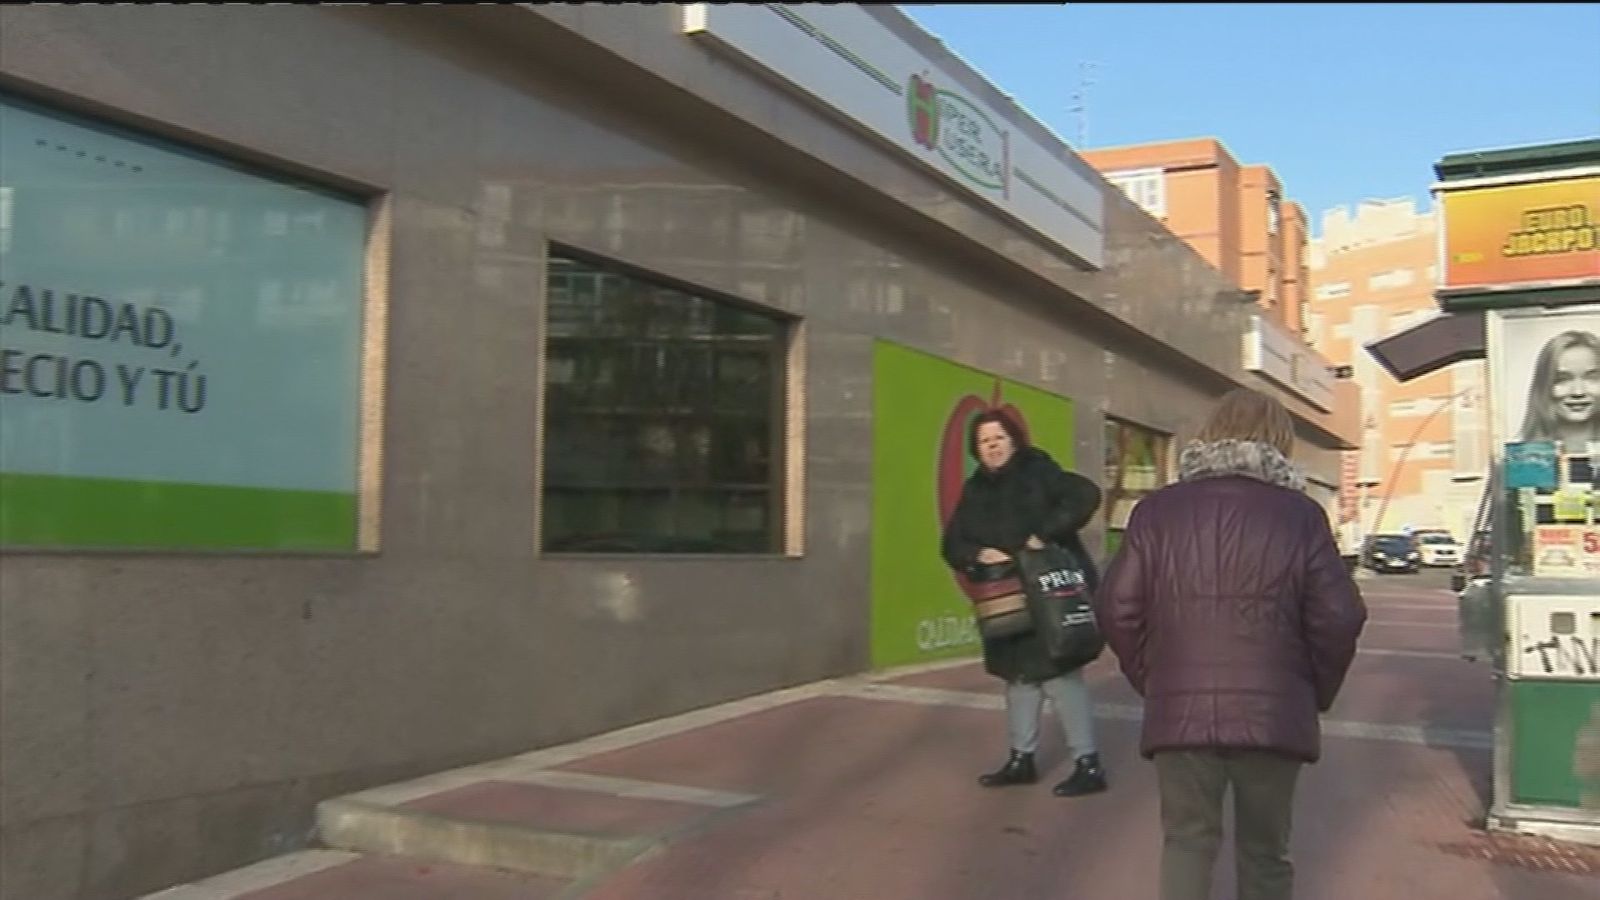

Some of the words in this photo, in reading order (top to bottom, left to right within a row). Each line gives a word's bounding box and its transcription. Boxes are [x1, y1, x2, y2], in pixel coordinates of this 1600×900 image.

[1523, 206, 1588, 232] EURO
[1503, 226, 1600, 257] JACKPO
[116, 364, 145, 406] Y
[152, 360, 207, 414] TÚ
